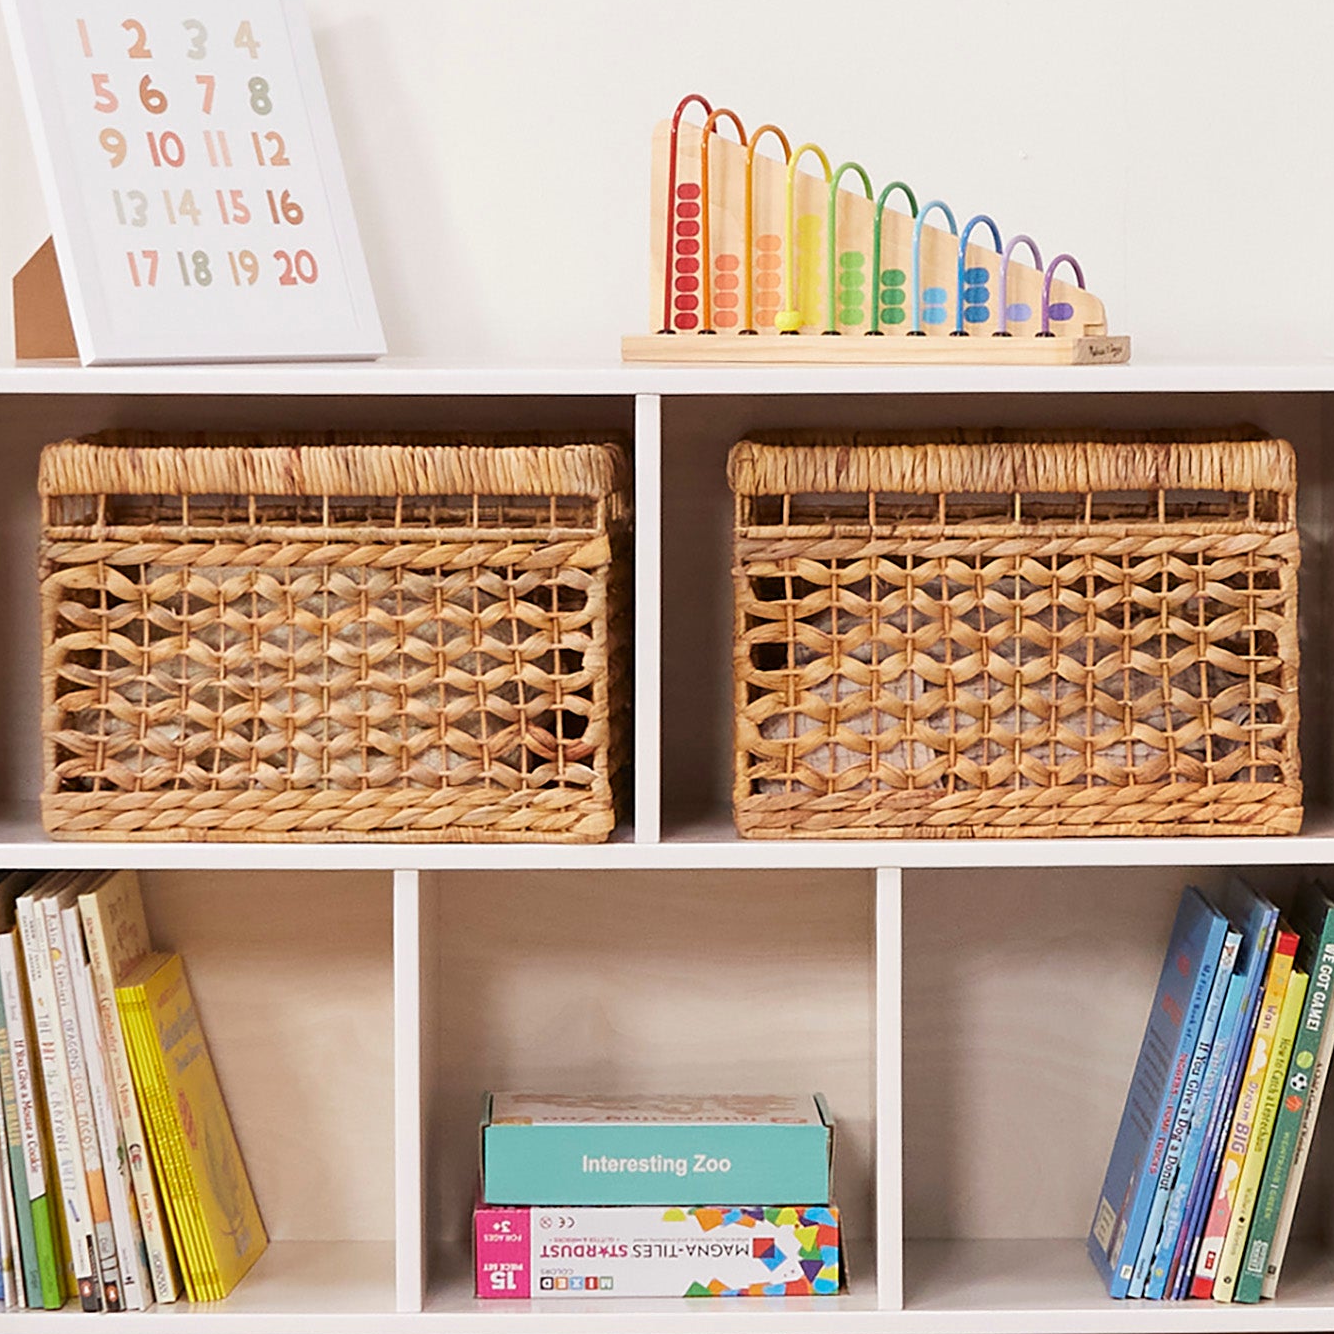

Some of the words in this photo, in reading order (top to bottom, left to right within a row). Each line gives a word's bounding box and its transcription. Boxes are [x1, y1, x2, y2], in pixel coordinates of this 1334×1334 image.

[76, 18, 93, 58] 1
[121, 18, 153, 59] 2
[181, 18, 208, 60] 3
[233, 20, 261, 59] 4
[91, 73, 119, 114] 5
[138, 74, 168, 115] 6
[195, 74, 216, 115] 7
[247, 76, 273, 116] 8
[98, 127, 127, 169] 9
[146, 130, 186, 168] 10
[203, 130, 233, 168] 11
[251, 130, 291, 167] 12
[111, 189, 148, 228] 13
[161, 189, 201, 226] 14
[216, 189, 251, 225] 15
[266, 188, 305, 226] 16
[126, 250, 160, 287] 17
[176, 249, 213, 287] 18
[227, 249, 260, 287] 19
[273, 249, 319, 287] 20
[1315, 964, 1332, 990] GOT
[1261, 1004, 1277, 1030] Wan
[1306, 990, 1327, 1031] GAME!
[14, 1039, 24, 1048] If
[1198, 1041, 1209, 1052] If
[1277, 1038, 1290, 1057] How
[15, 1050, 26, 1067] You
[1191, 1054, 1205, 1076] You
[17, 1069, 29, 1090] Give
[63, 1018, 80, 1070] DRAGONS
[77, 1111, 93, 1151] TACOS
[1183, 1078, 1199, 1105] Give
[1268, 1069, 1283, 1094] Catch
[1240, 1080, 1258, 1121] Dream
[22, 1100, 35, 1131] Mouse
[1253, 1102, 1275, 1153] Leprechaun
[1172, 1118, 1188, 1141] Dog
[1230, 1122, 1249, 1153] BIG
[27, 1140, 40, 1174] Cookie
[582, 1154, 687, 1177] Interesting
[692, 1154, 731, 1173] Zoo
[1158, 1155, 1177, 1191] Donut
[632, 1244, 750, 1258] MAGNA-TILES
[489, 1270, 517, 1290] 15
[540, 1276, 613, 1290] MIXED
